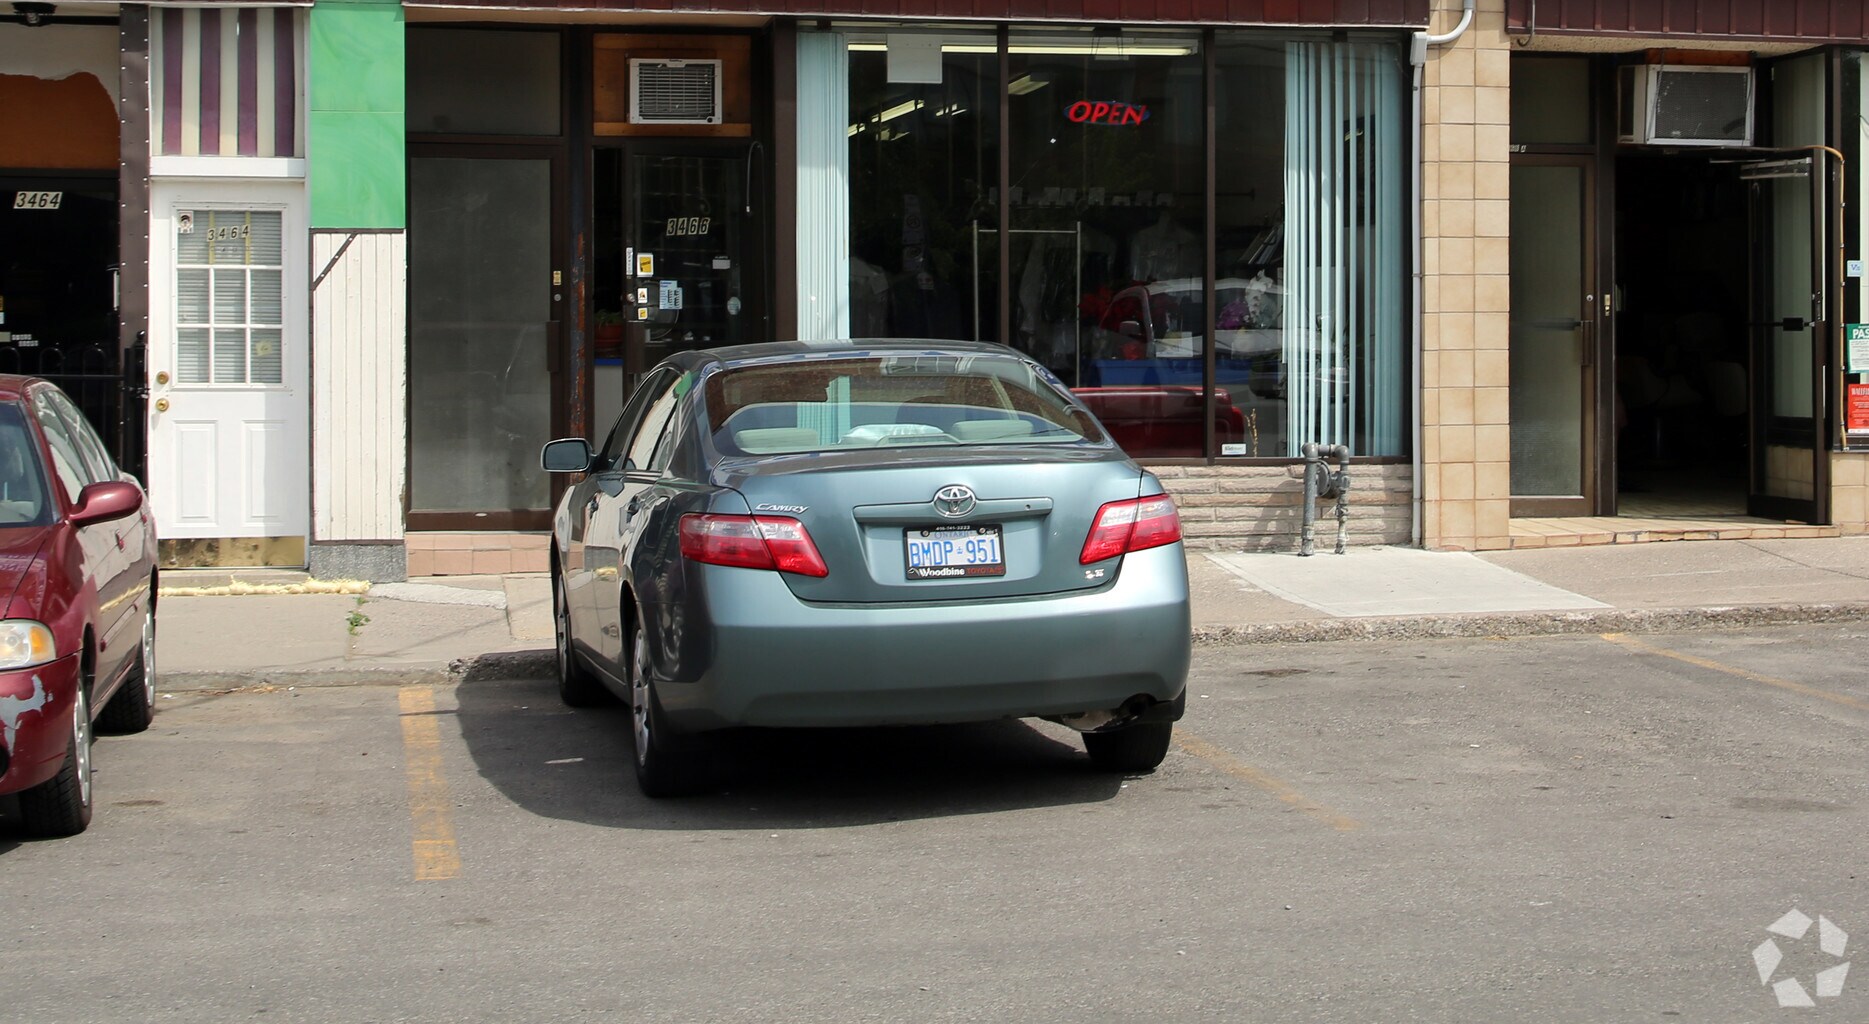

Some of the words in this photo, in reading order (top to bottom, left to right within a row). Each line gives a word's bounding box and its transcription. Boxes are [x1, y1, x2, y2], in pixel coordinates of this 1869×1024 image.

[1068, 101, 1147, 125] OPEN
[15, 192, 61, 208] 3464
[207, 226, 250, 241] 3464
[667, 218, 710, 235] 3466
[910, 540, 954, 567] BMDP
[965, 539, 998, 564] 951
[919, 567, 965, 577] Woodbine
